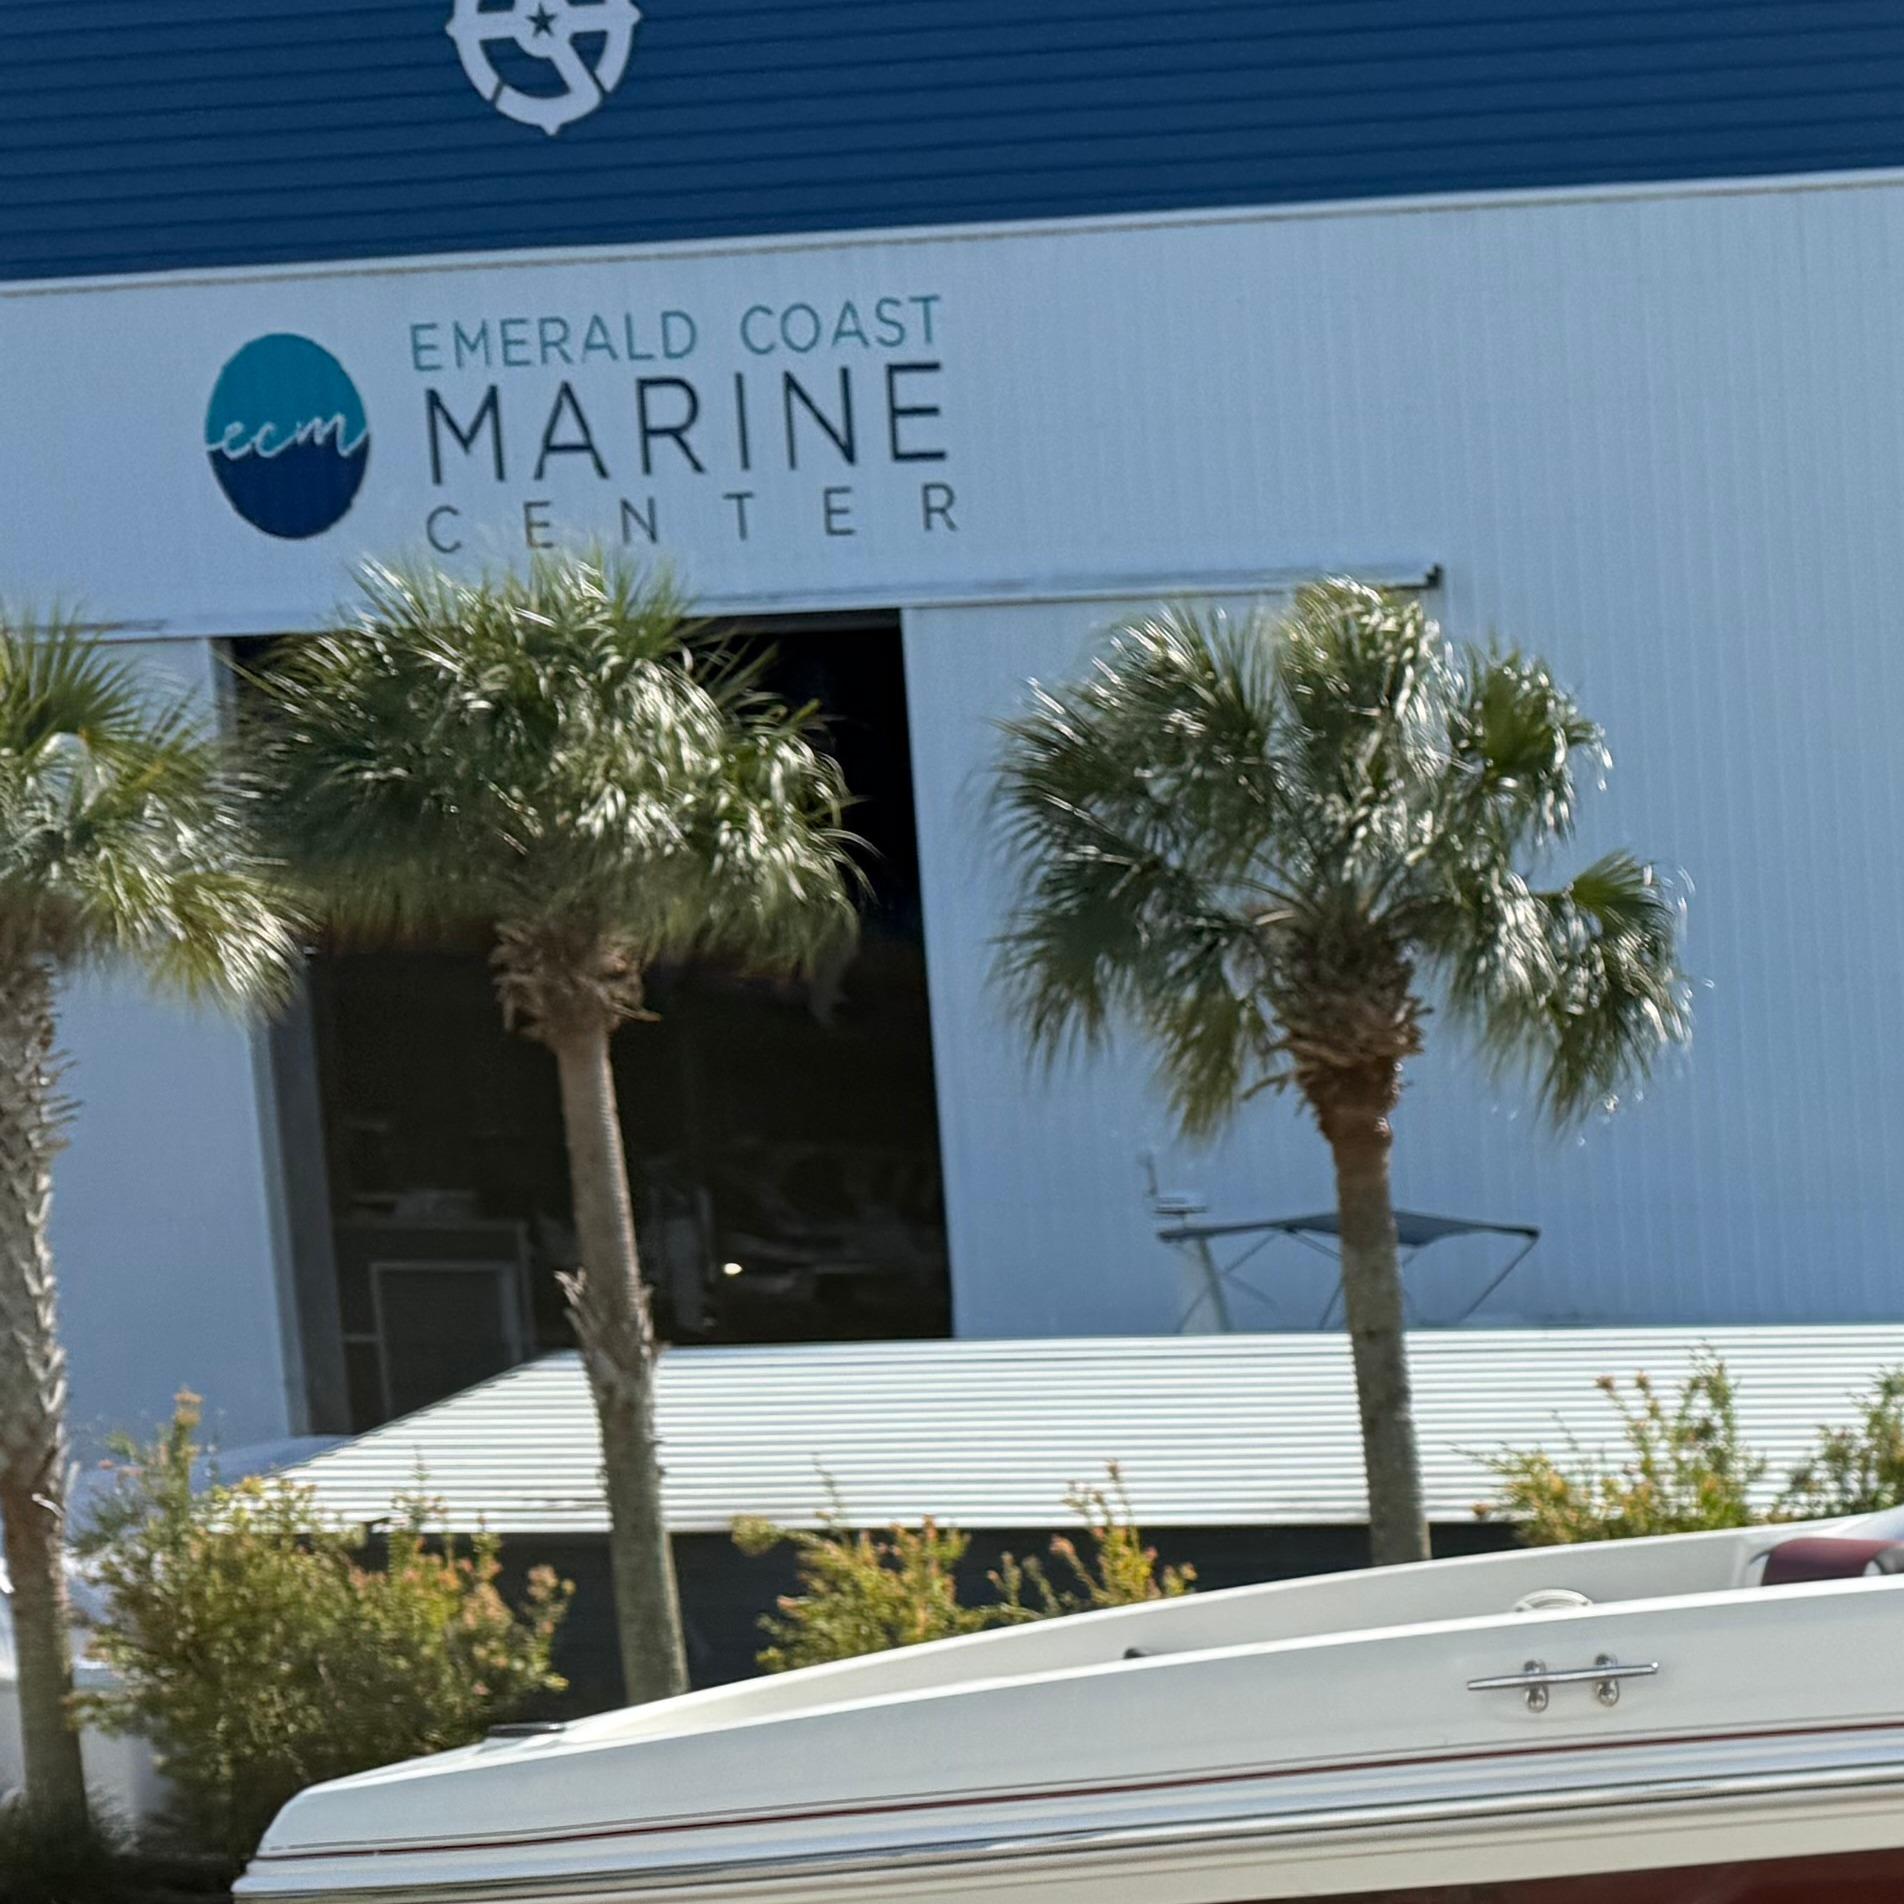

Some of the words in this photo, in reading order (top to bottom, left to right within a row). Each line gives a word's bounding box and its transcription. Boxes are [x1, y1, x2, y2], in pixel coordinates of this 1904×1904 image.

[410, 308, 698, 372] EMERALD
[739, 294, 942, 356] COAST
[206, 411, 368, 461] ecm
[423, 361, 949, 487] MARINE
[424, 483, 959, 555] CENTER
